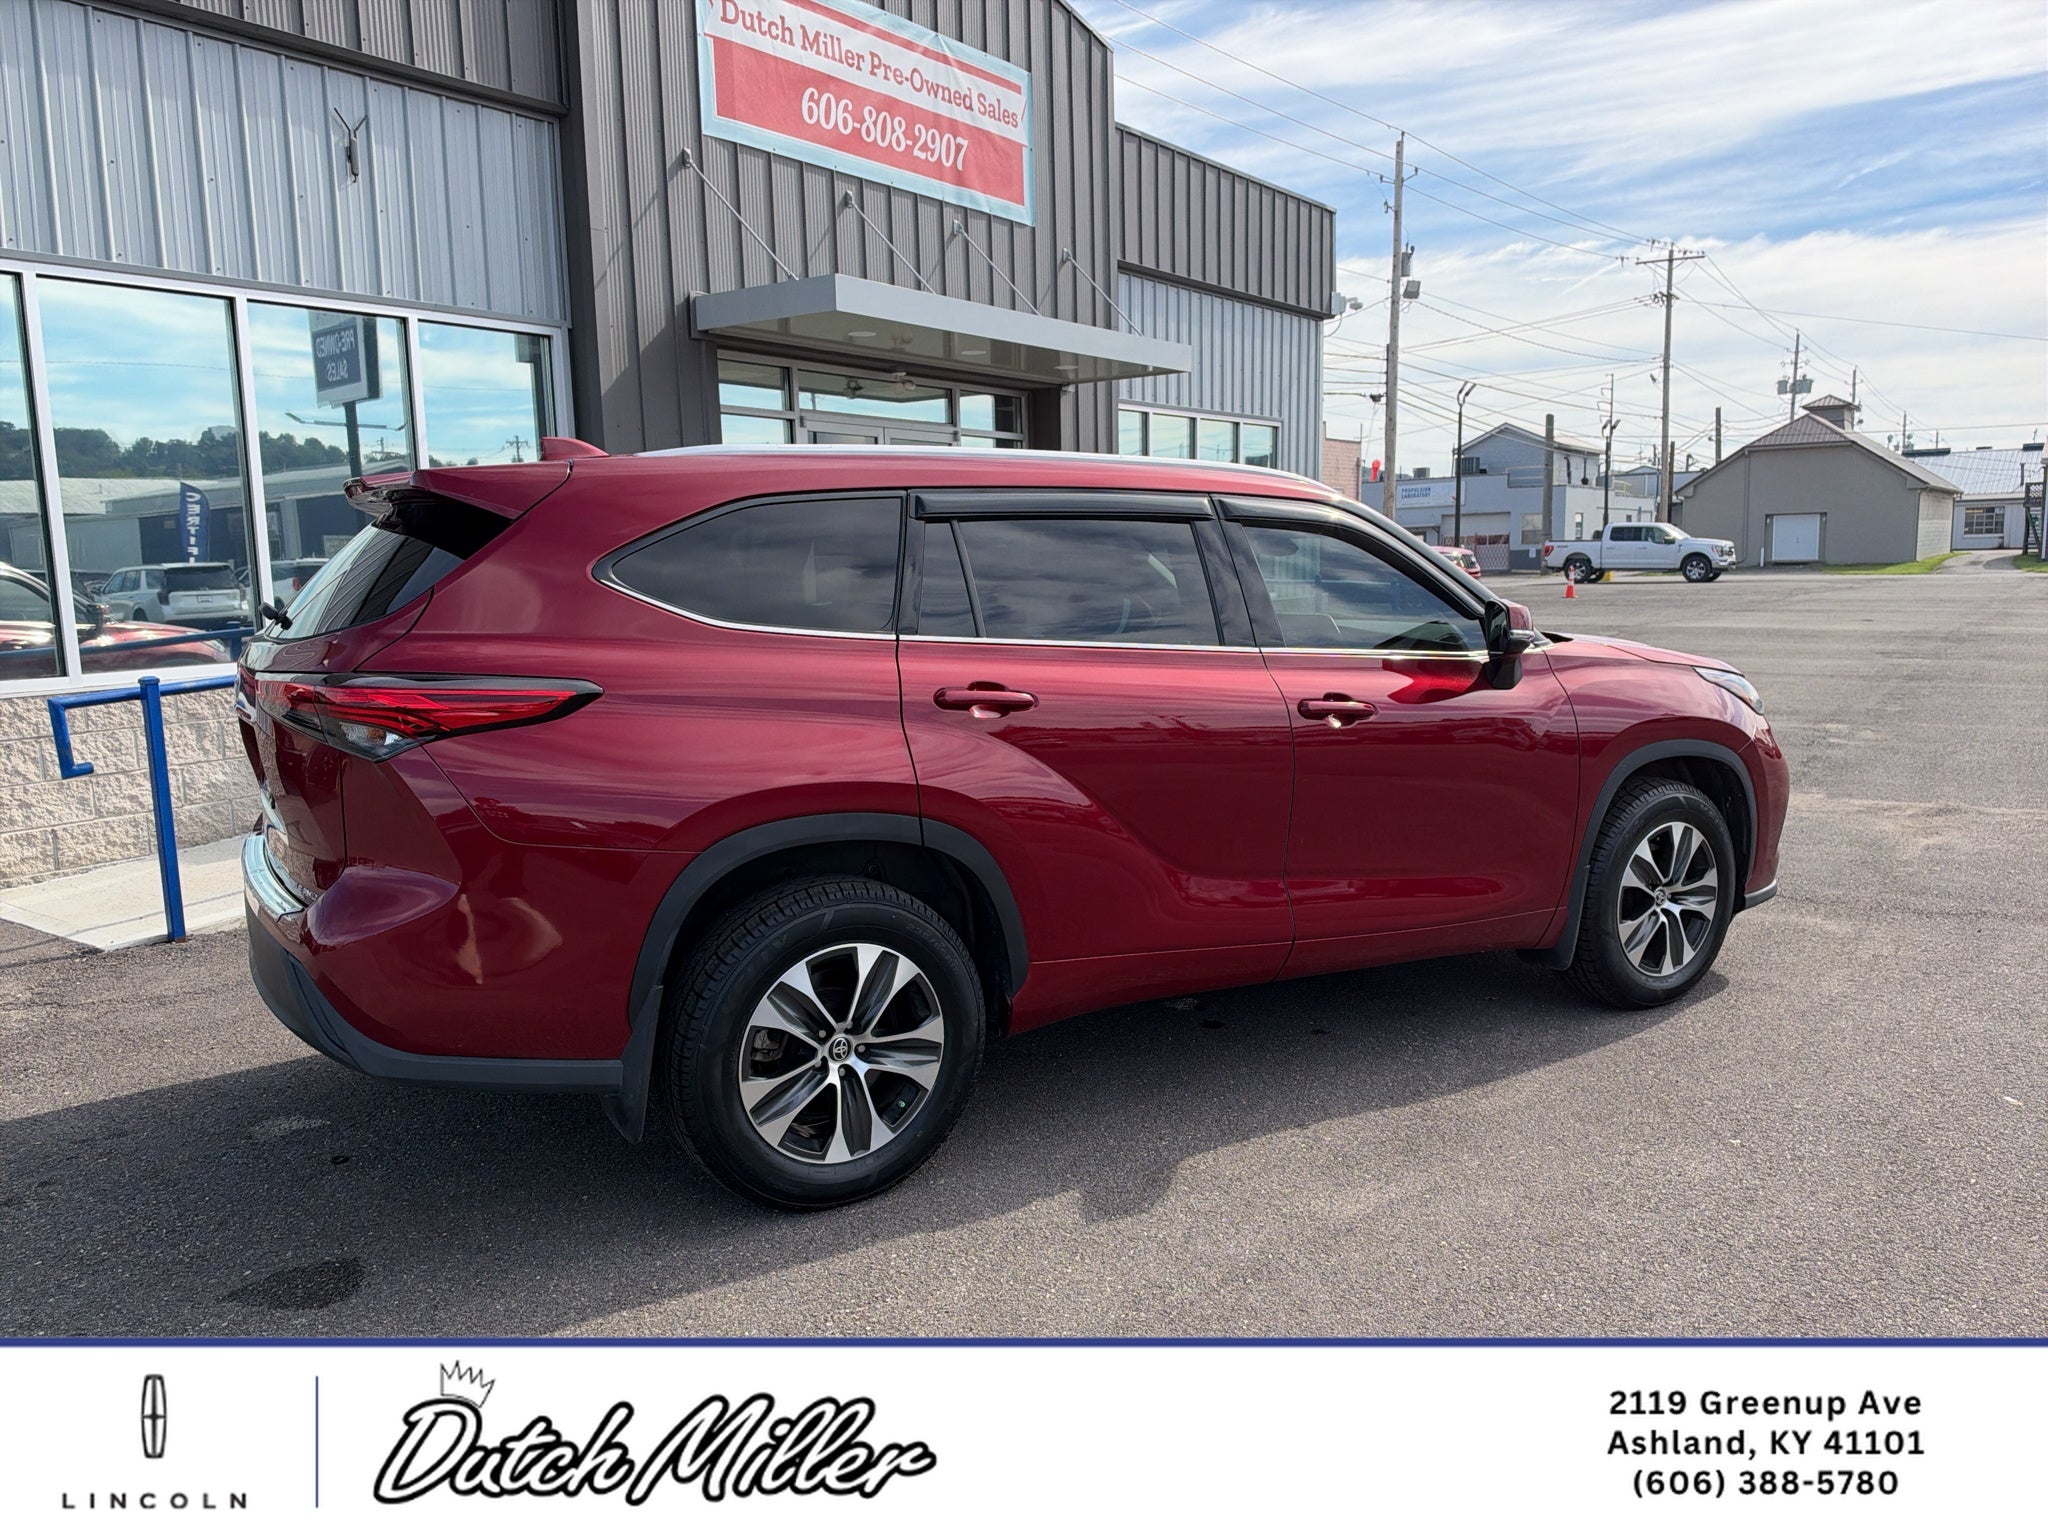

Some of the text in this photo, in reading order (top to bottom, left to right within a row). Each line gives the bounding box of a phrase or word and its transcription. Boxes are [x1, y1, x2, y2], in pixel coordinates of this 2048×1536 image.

[720, 0, 1018, 128] Dutch Miller Pre-Owned Sales
[802, 87, 968, 171] 606-808-2907
